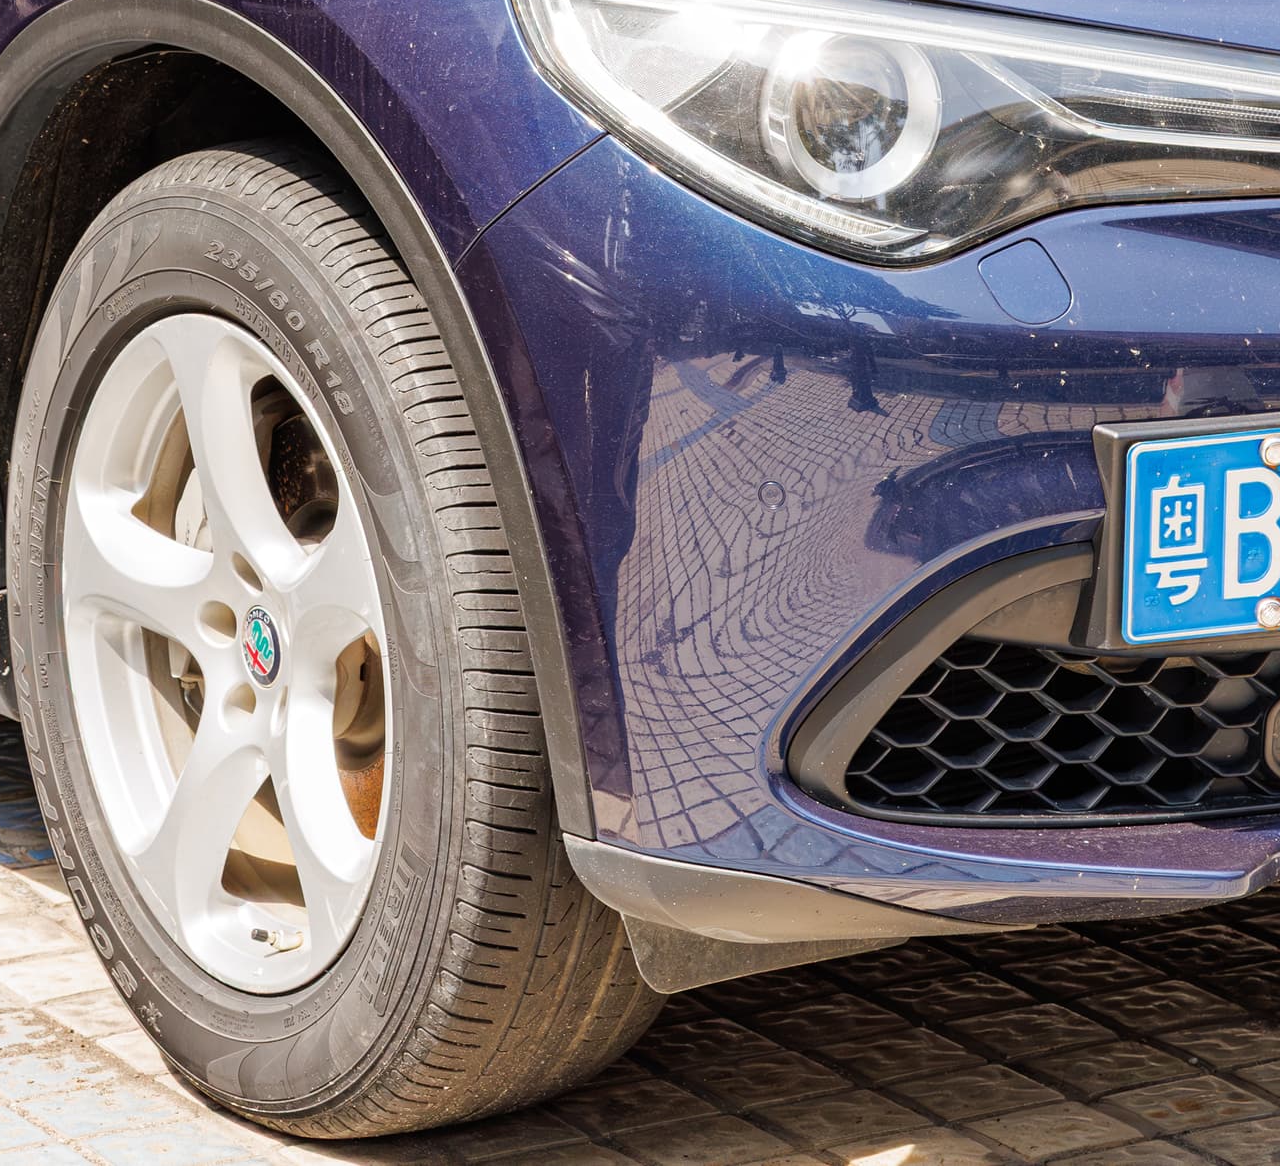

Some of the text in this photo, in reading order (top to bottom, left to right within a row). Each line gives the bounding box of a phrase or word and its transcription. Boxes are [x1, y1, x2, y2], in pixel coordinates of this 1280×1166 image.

[203, 239, 307, 332] 235/60
[303, 338, 354, 416] R18
[12, 635, 139, 1000] SCORPION
[356, 840, 433, 1018] PIRELLI
